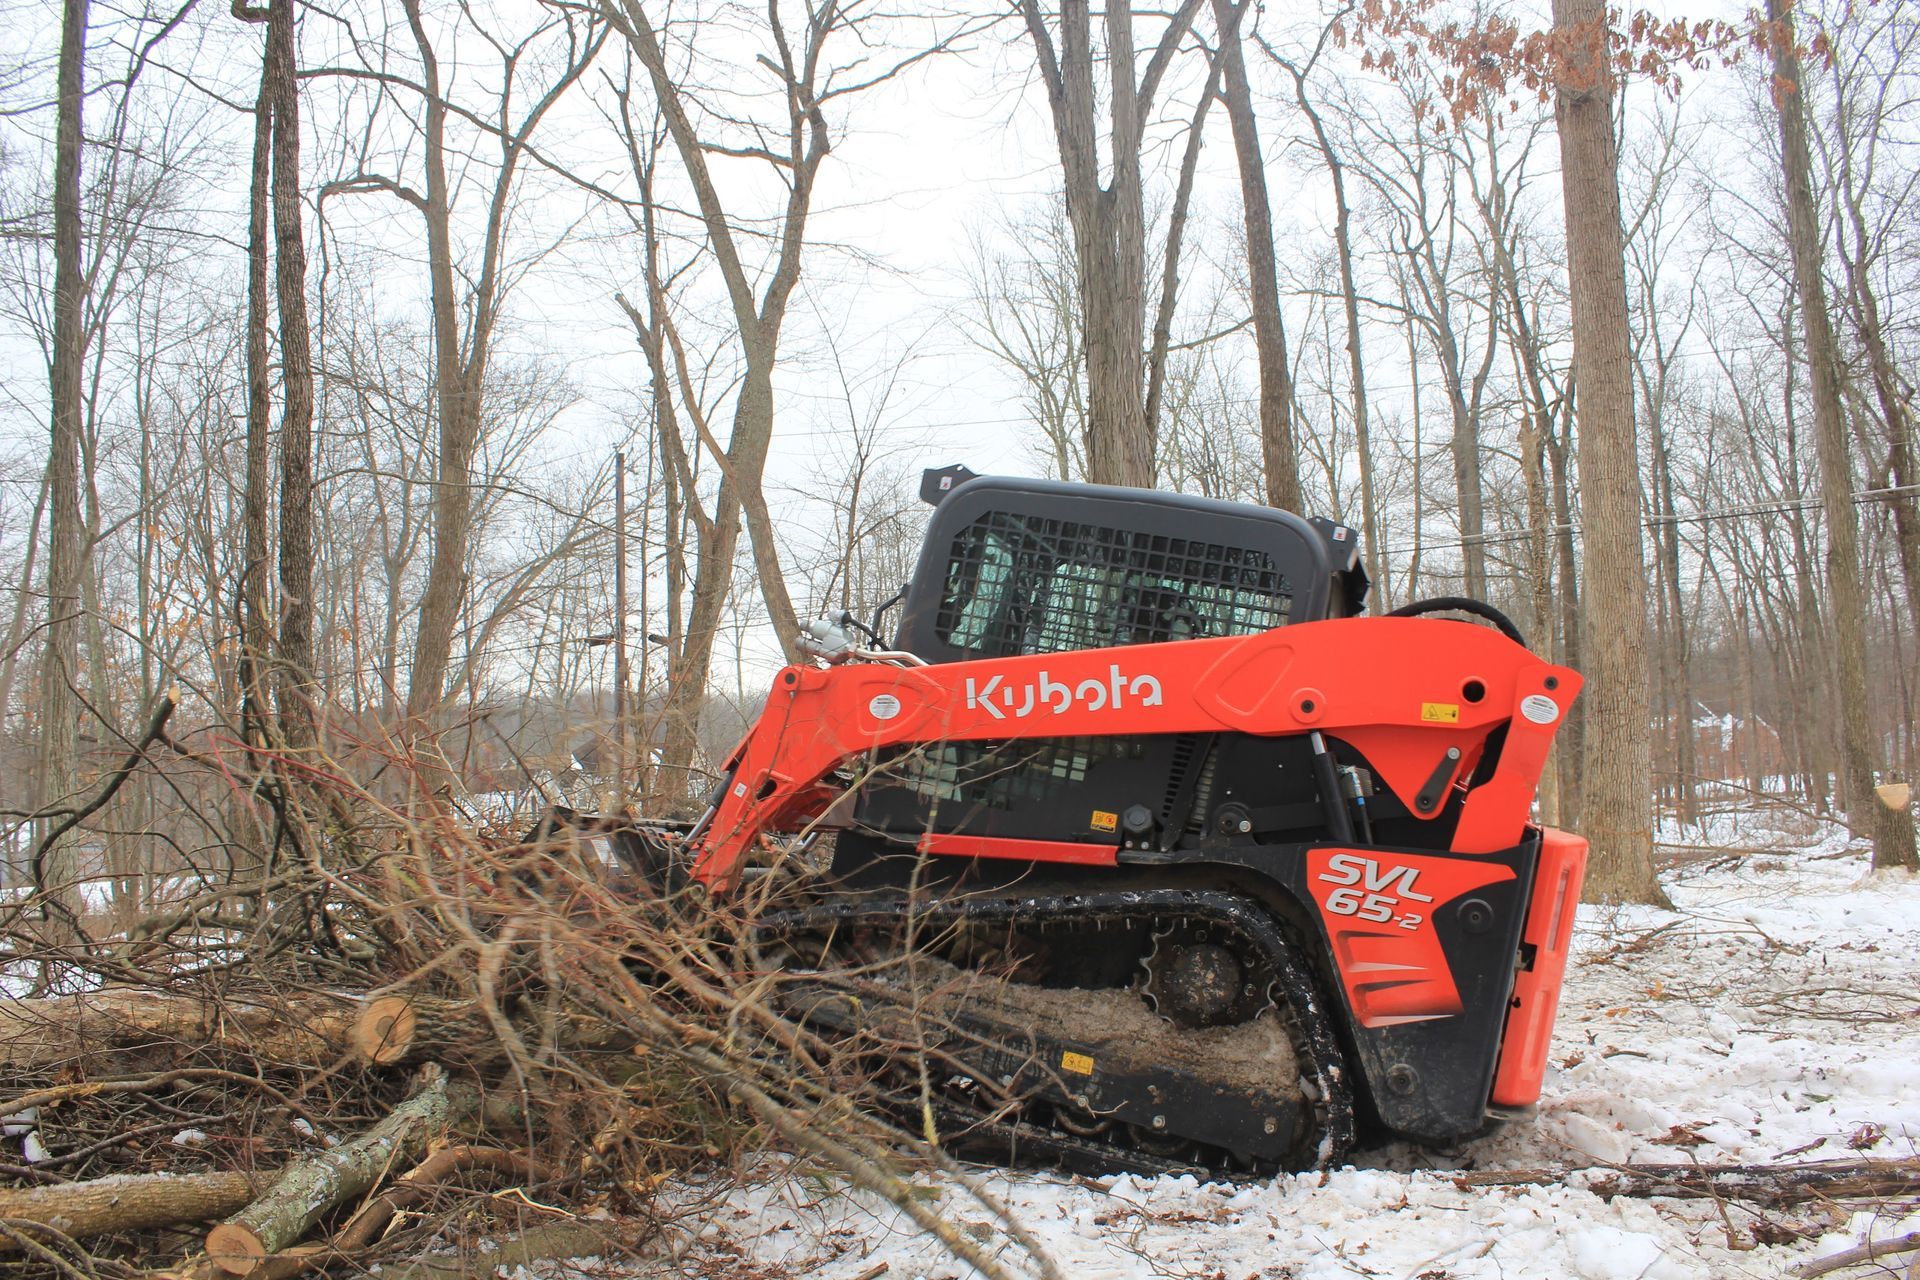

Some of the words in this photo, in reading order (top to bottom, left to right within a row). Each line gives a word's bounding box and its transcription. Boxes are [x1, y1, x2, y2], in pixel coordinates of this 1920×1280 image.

[965, 664, 1163, 720] Kubota
[1318, 853, 1433, 903] SVL
[1325, 887, 1423, 930] 65-2
